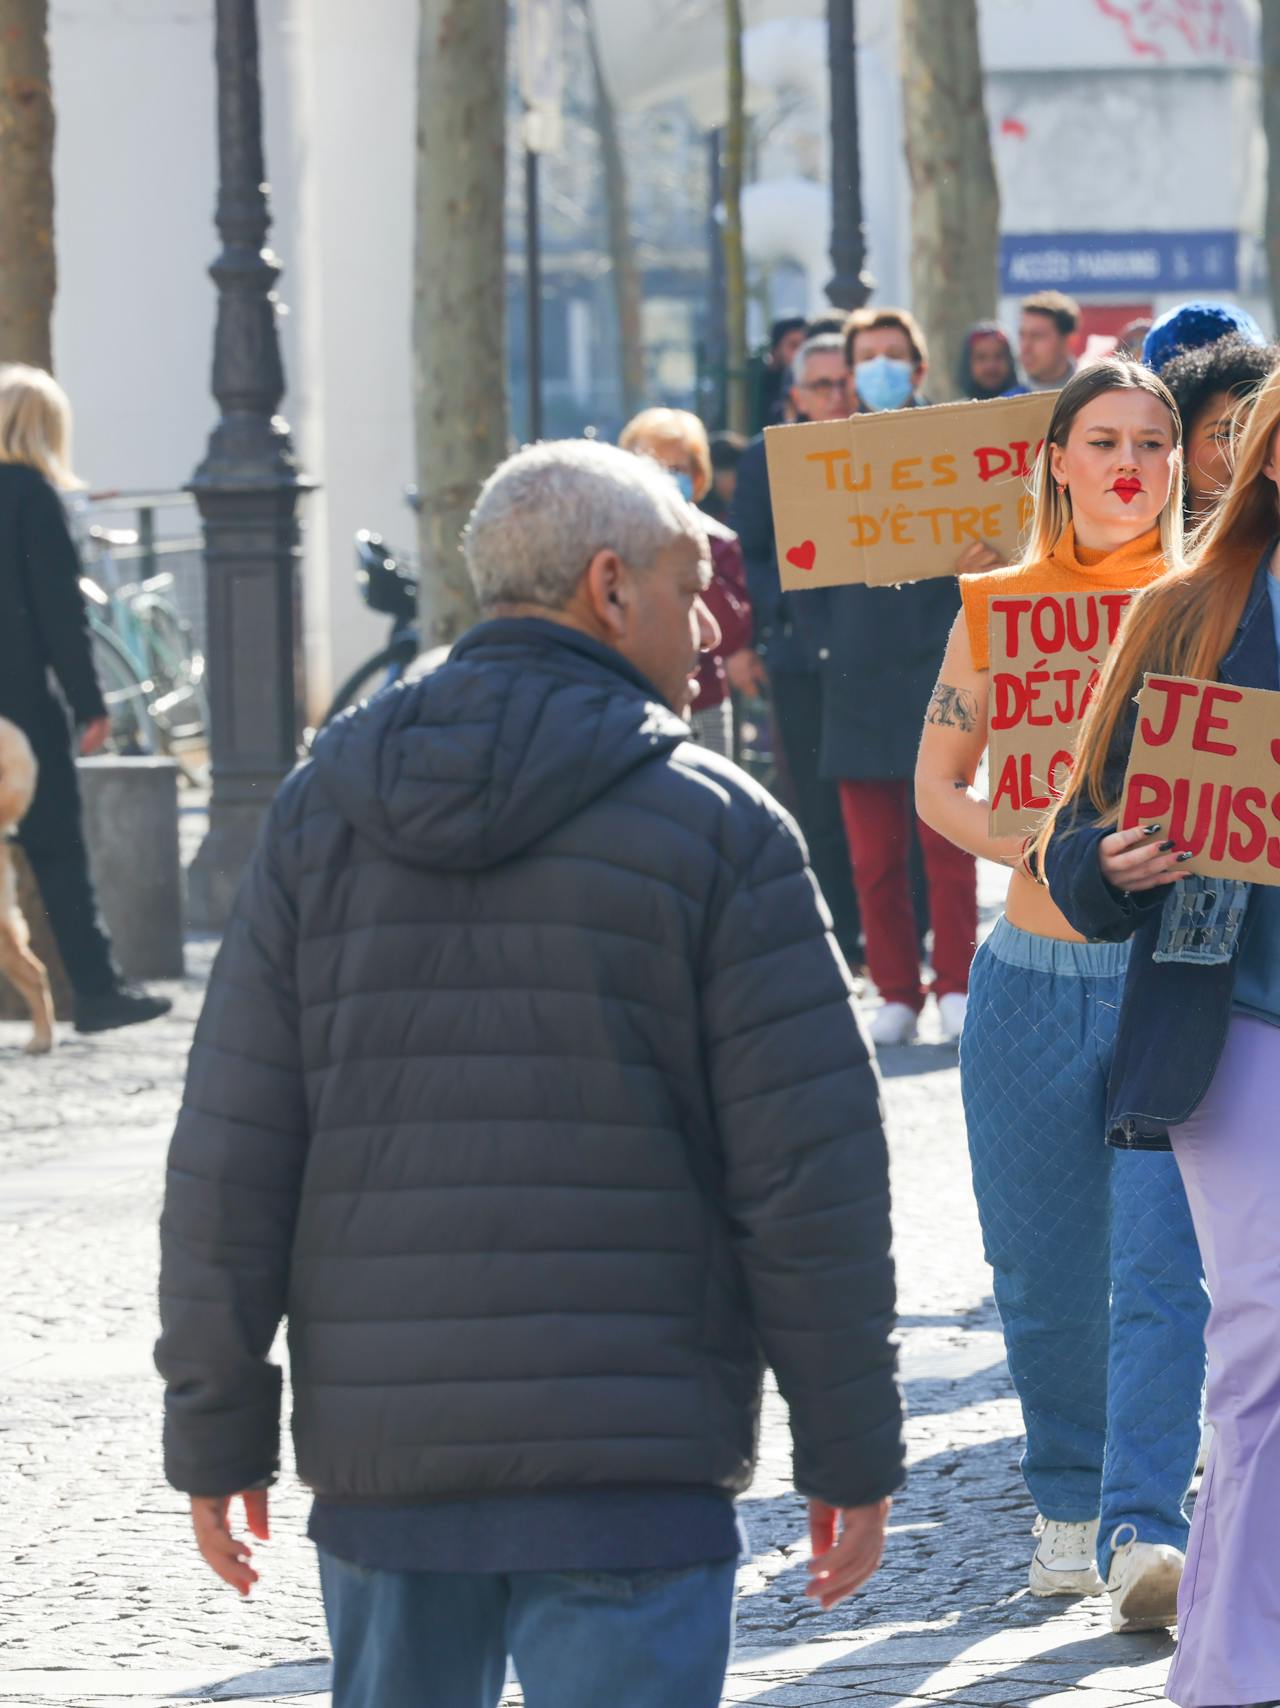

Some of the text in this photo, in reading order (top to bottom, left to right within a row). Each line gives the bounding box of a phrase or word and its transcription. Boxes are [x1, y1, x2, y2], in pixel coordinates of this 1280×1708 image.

[806, 439, 1045, 492] TU ES DI
[848, 503, 1002, 548] D'ÊTRE
[991, 594, 1132, 658] TOUT
[1141, 679, 1244, 757] JE
